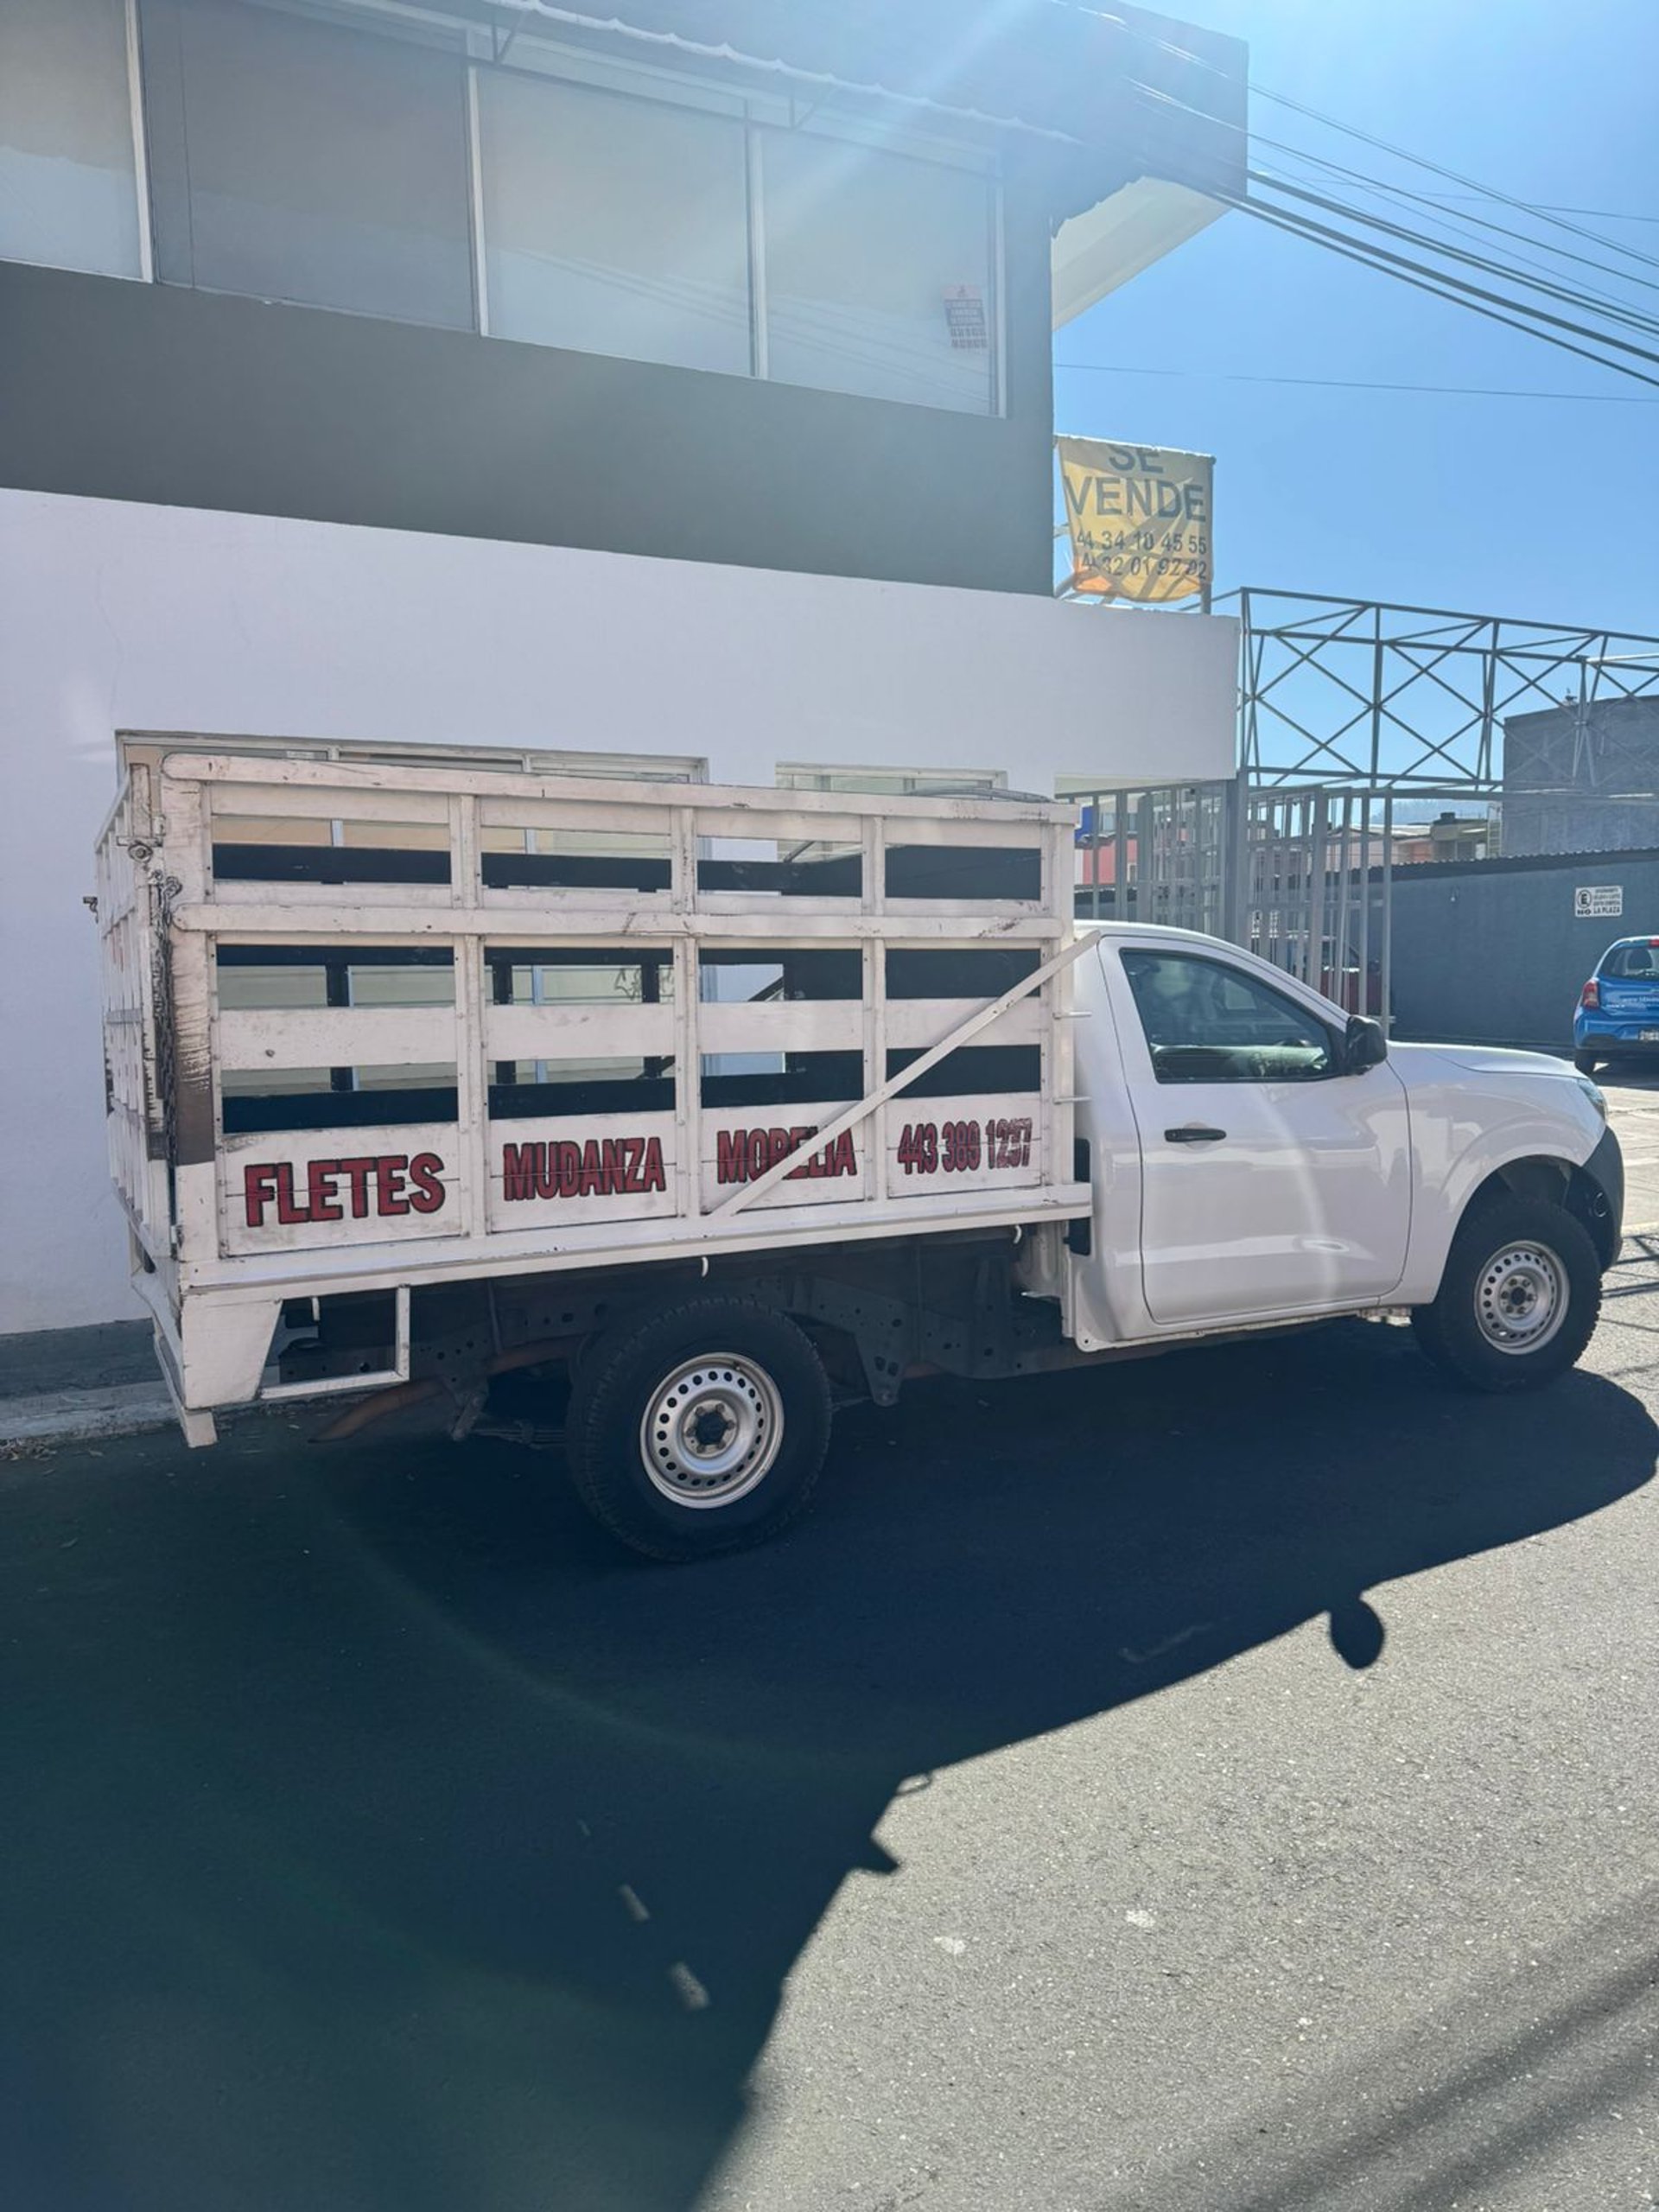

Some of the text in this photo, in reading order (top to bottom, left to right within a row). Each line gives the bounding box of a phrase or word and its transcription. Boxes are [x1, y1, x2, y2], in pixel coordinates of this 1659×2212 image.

[1107, 443, 1164, 474] SE
[1064, 475, 1206, 523] VENDE
[1102, 530, 1124, 550] 34
[1161, 531, 1183, 552] 45
[1188, 534, 1207, 555] 55
[244, 1152, 446, 1228] FLETES
[503, 1136, 667, 1202] MUDANZA
[897, 1122, 938, 1176] 443
